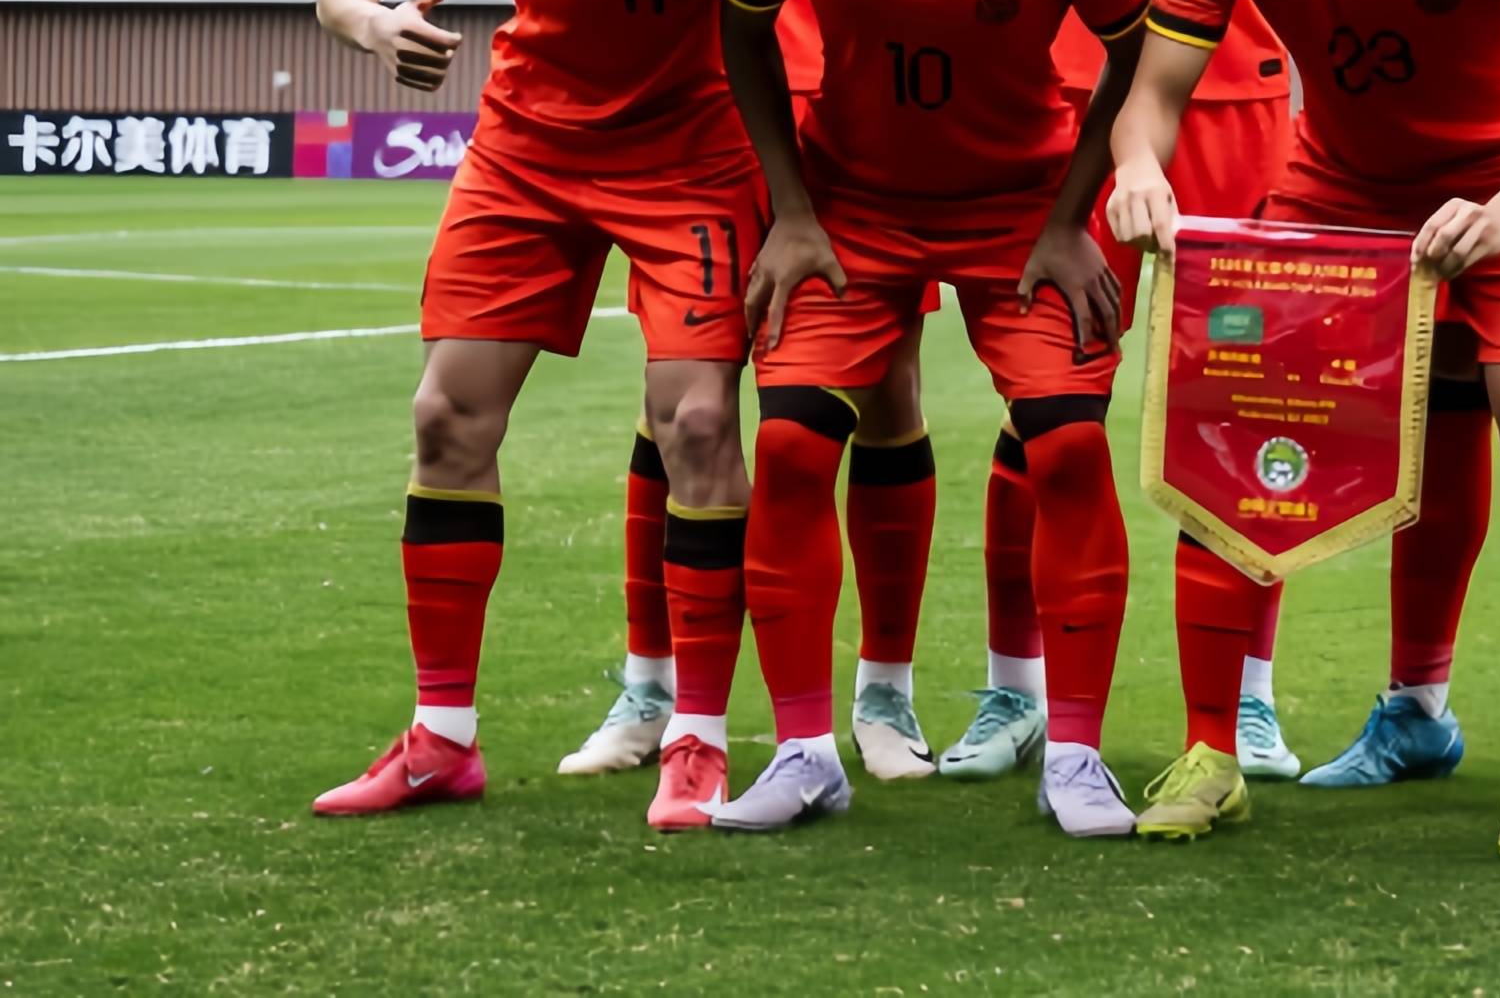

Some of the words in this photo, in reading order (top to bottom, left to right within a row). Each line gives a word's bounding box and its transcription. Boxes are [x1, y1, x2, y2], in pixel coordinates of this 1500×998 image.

[885, 41, 952, 109] 10
[1328, 27, 1416, 95] 23
[8, 114, 275, 175] 卡尔美体育
[690, 218, 742, 297] 11
